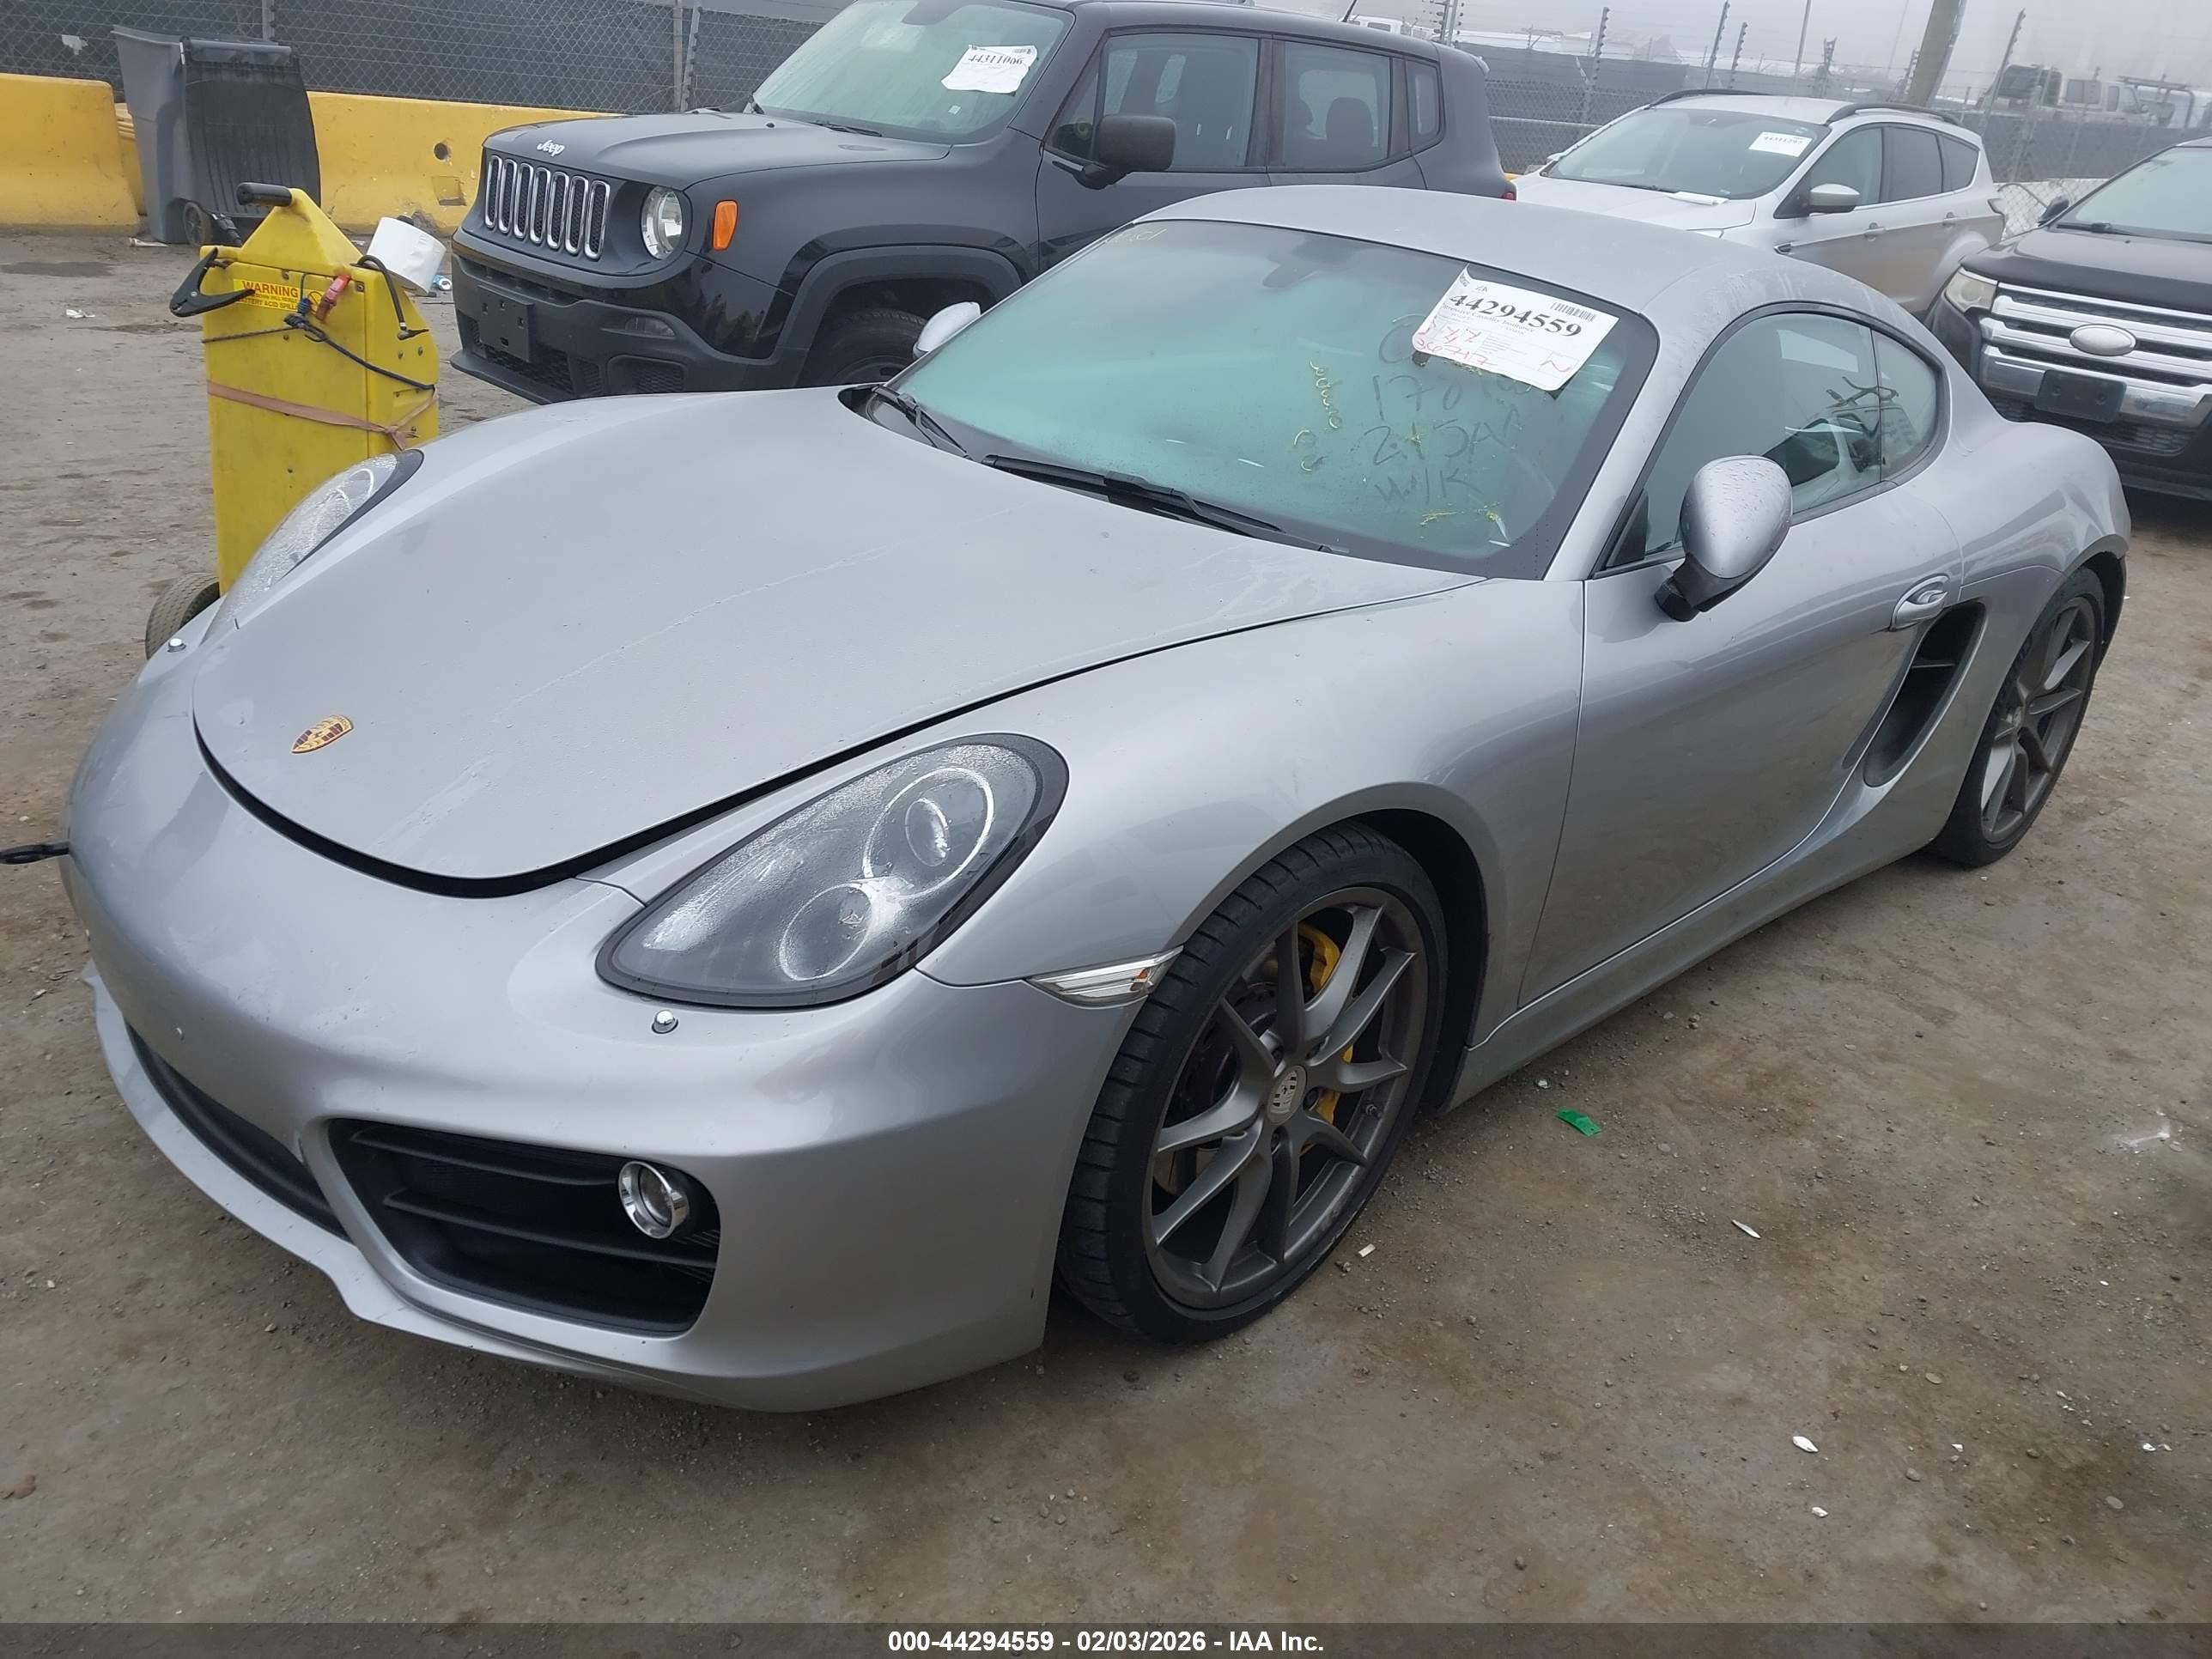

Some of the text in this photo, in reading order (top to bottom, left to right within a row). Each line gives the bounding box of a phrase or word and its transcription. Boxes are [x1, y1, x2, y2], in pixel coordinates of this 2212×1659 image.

[537, 140, 565, 156] Jeep
[242, 281, 298, 298] WARNING
[1449, 295, 1583, 337] 44294559
